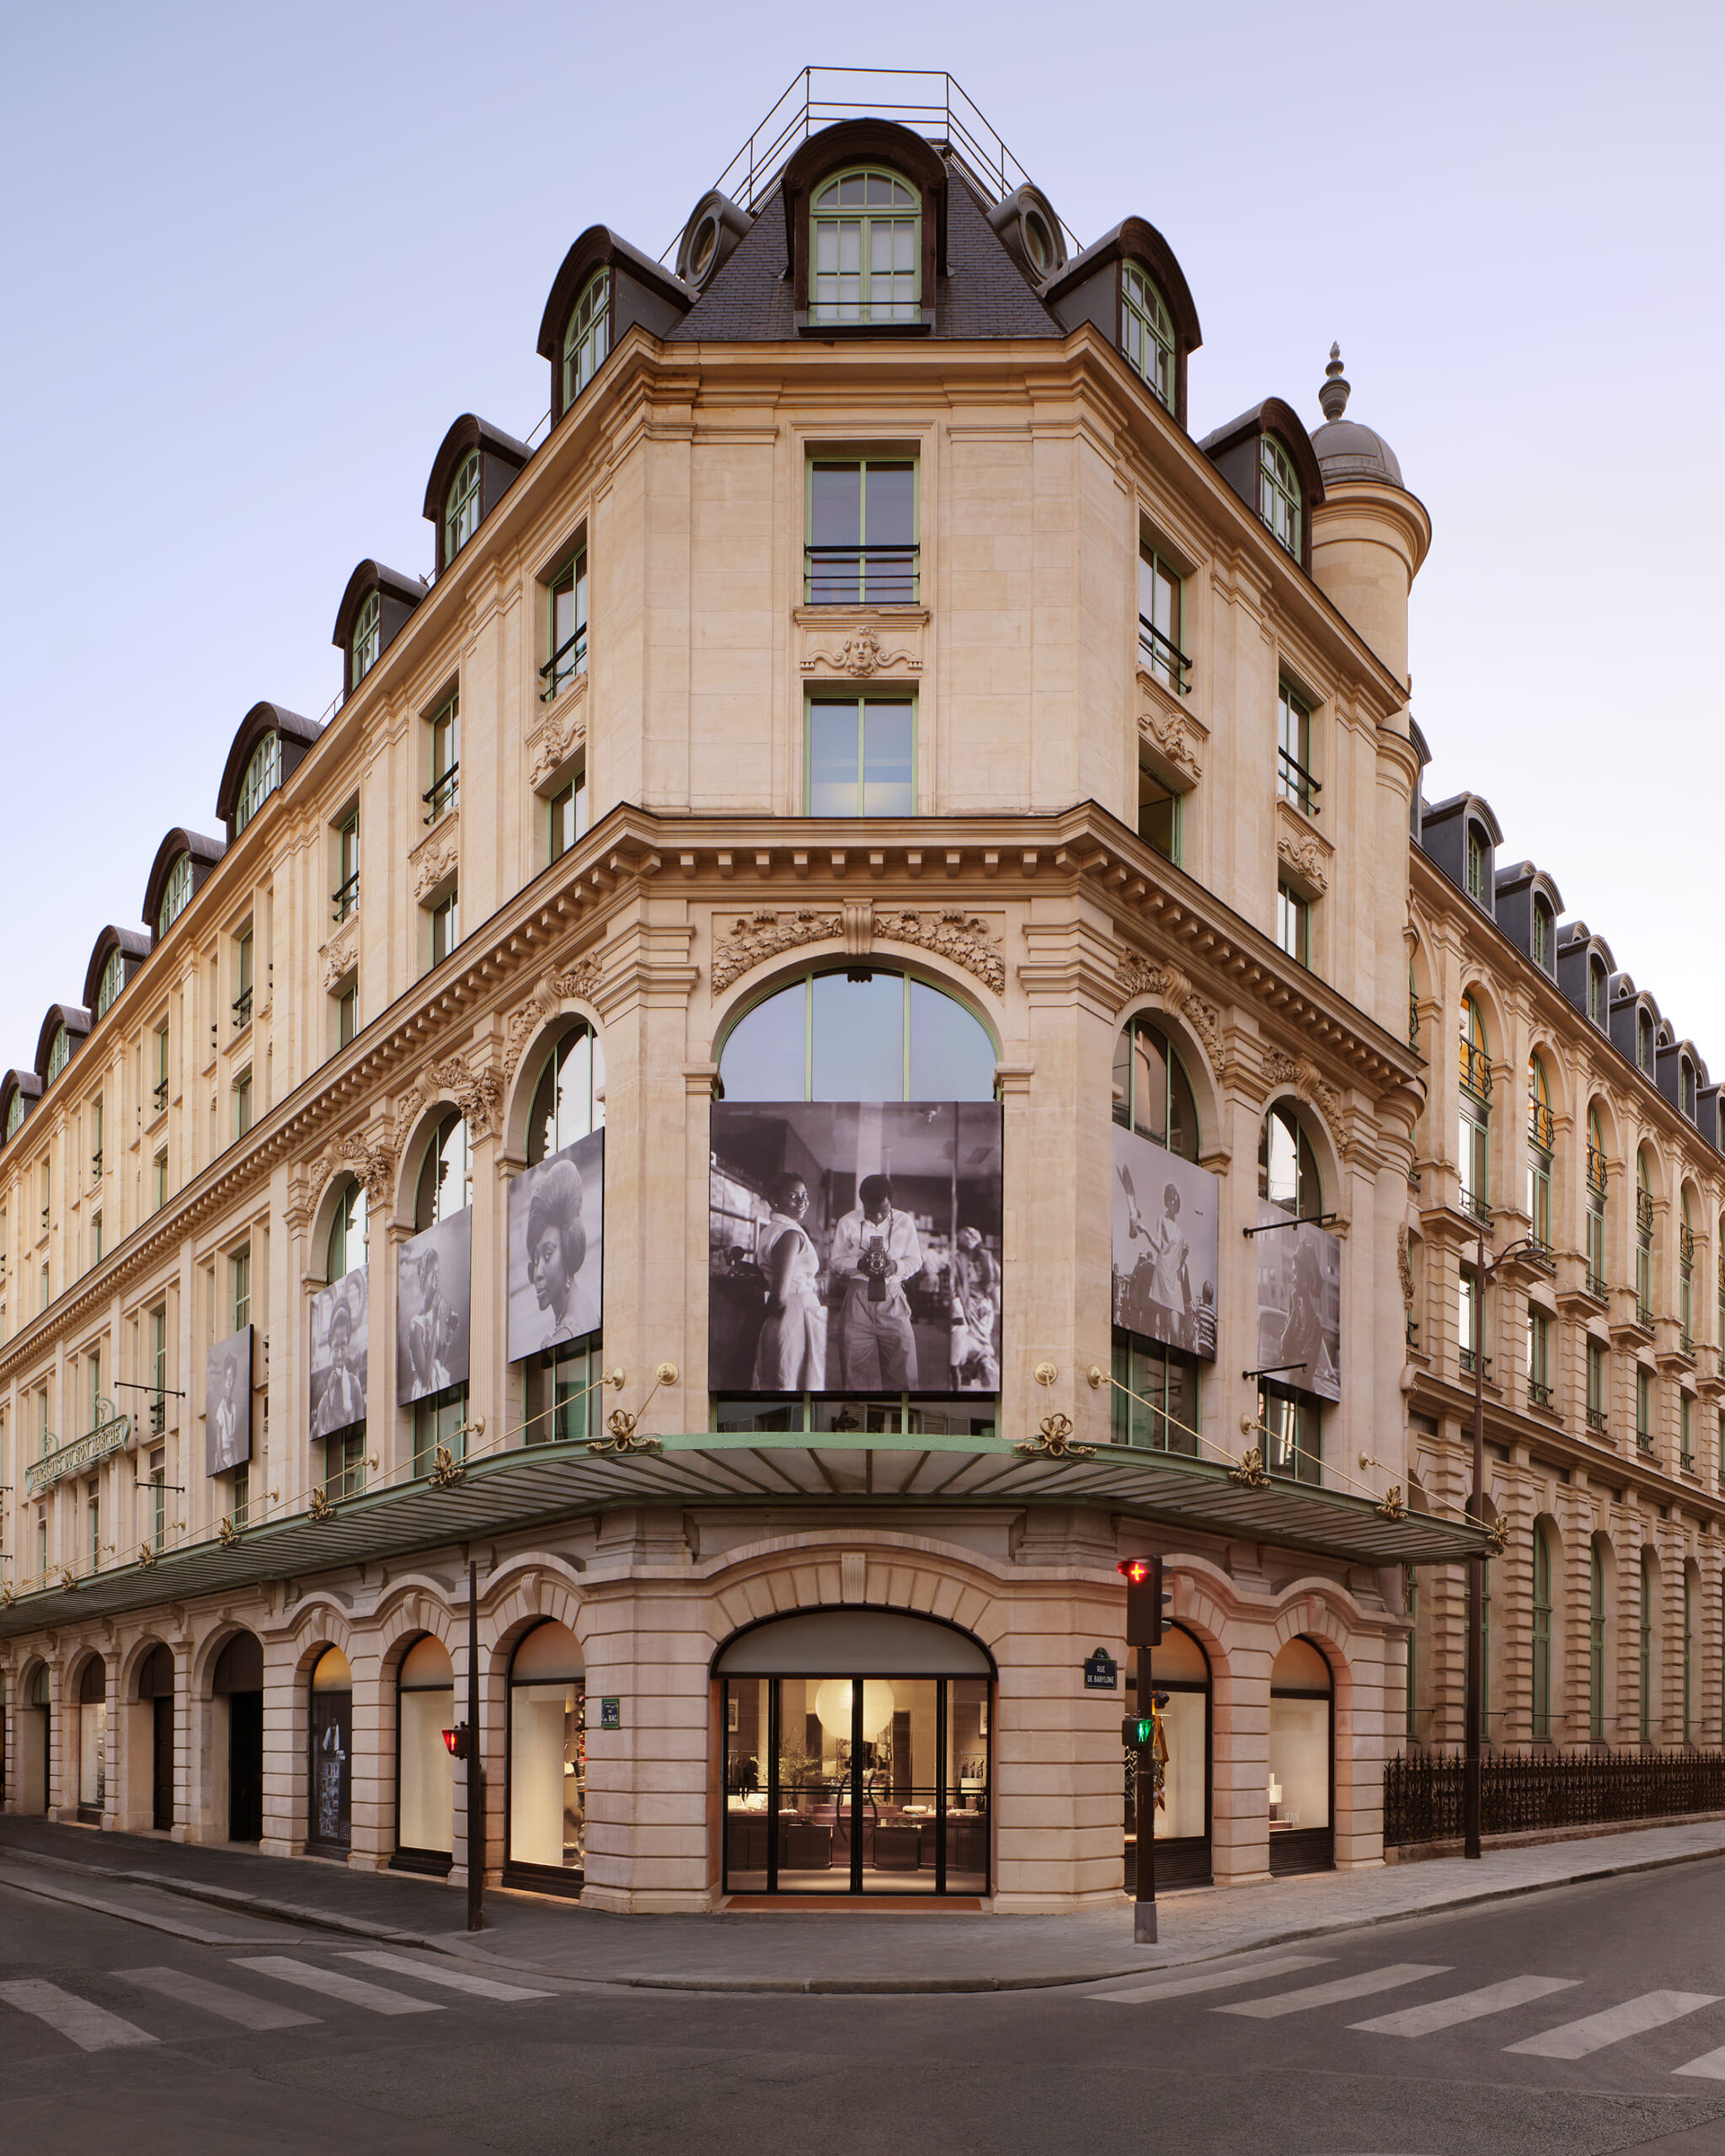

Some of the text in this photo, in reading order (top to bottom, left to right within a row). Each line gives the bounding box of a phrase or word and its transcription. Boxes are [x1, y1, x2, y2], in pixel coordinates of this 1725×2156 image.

[1097, 1665, 1105, 1673] RUE
[1087, 1674, 1114, 1684] DE BABYLONE
